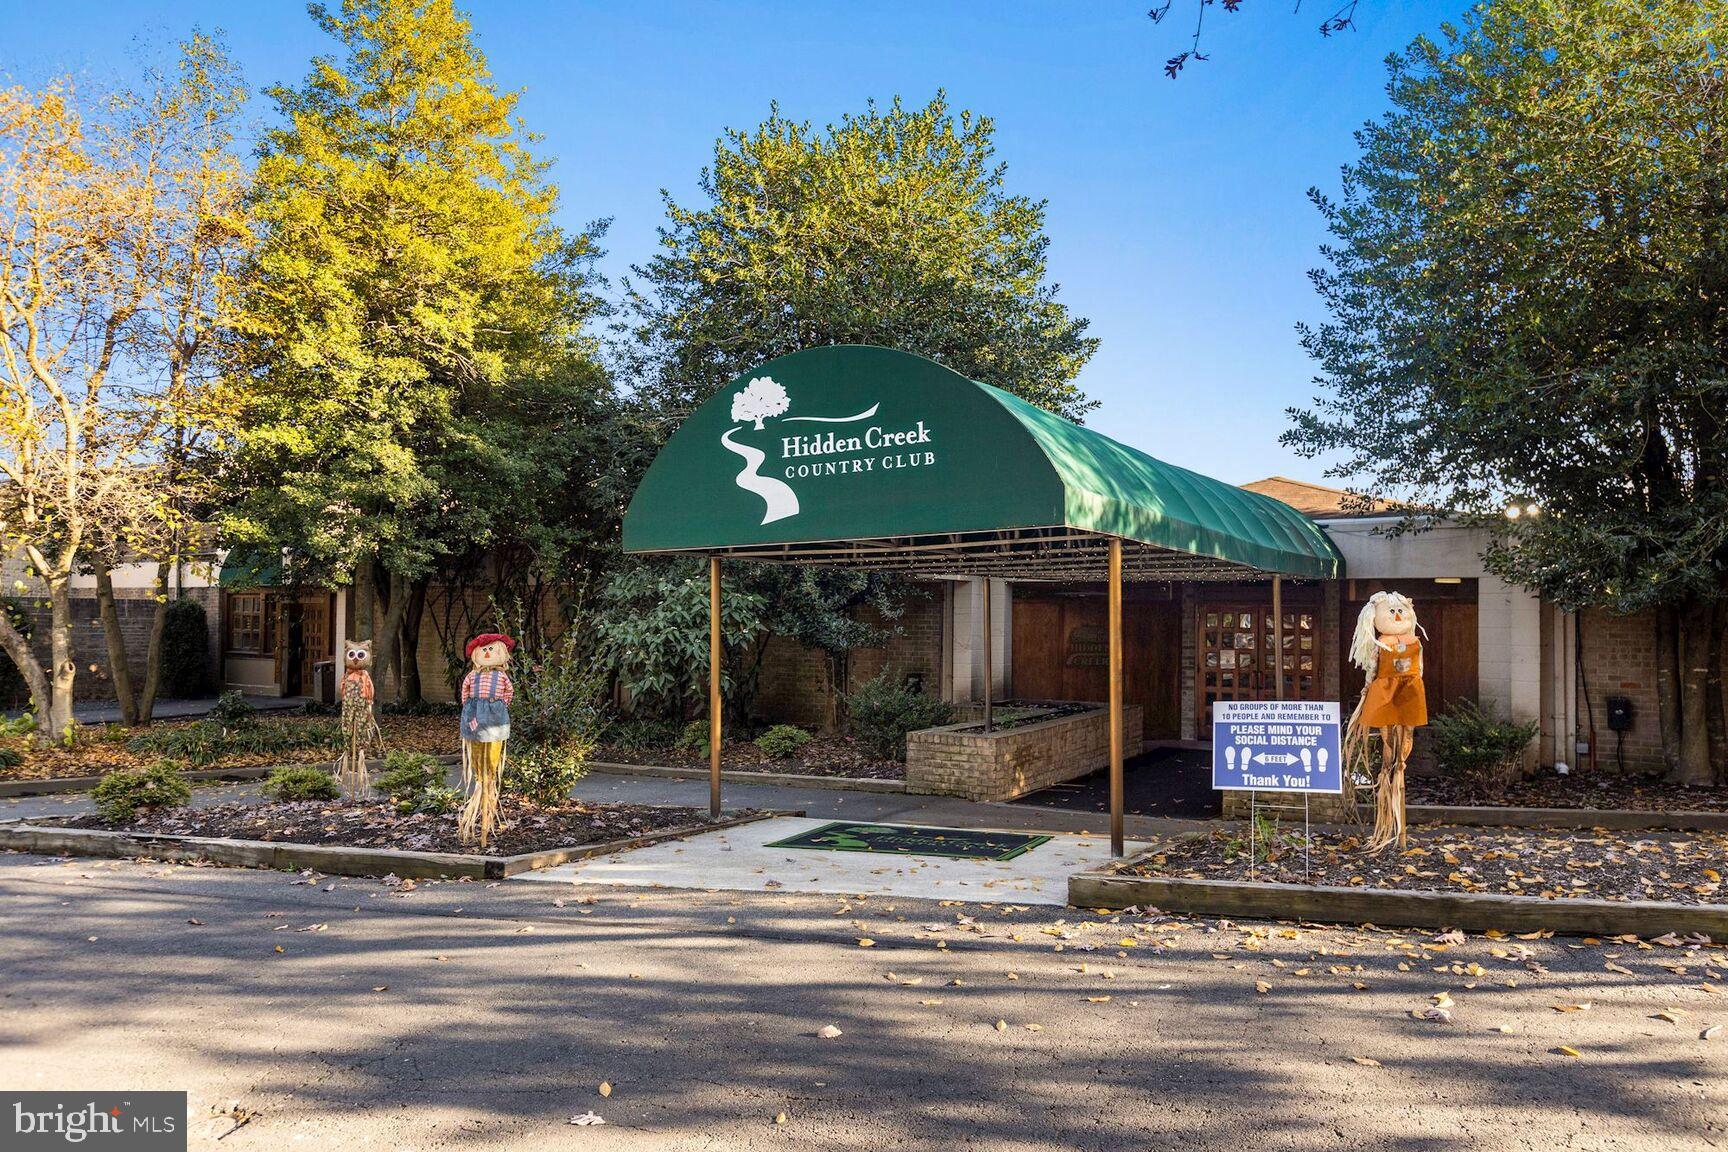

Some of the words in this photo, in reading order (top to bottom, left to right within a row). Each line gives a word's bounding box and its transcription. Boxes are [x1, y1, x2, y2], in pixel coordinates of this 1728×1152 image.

[781, 432, 862, 458] Hidden
[865, 420, 931, 449] Creek
[785, 458, 875, 479] COUNTRY
[882, 451, 935, 469] CLUB
[1228, 703, 1238, 711] NO
[1239, 703, 1268, 711] GROUPS
[1269, 703, 1279, 711] OF
[1281, 703, 1302, 711] MORE
[1277, 713, 1320, 721] REMEMBER
[1321, 713, 1331, 721] TO
[1230, 725, 1265, 735] PLEASE
[1267, 725, 1293, 735] MIND
[1295, 725, 1322, 736] YOUR
[1235, 735, 1269, 745] SOCIAL
[1270, 736, 1318, 746] DISTANCE
[1270, 755, 1287, 763] FEET
[1241, 774, 1279, 787] Thank
[1282, 774, 1311, 788] You!
